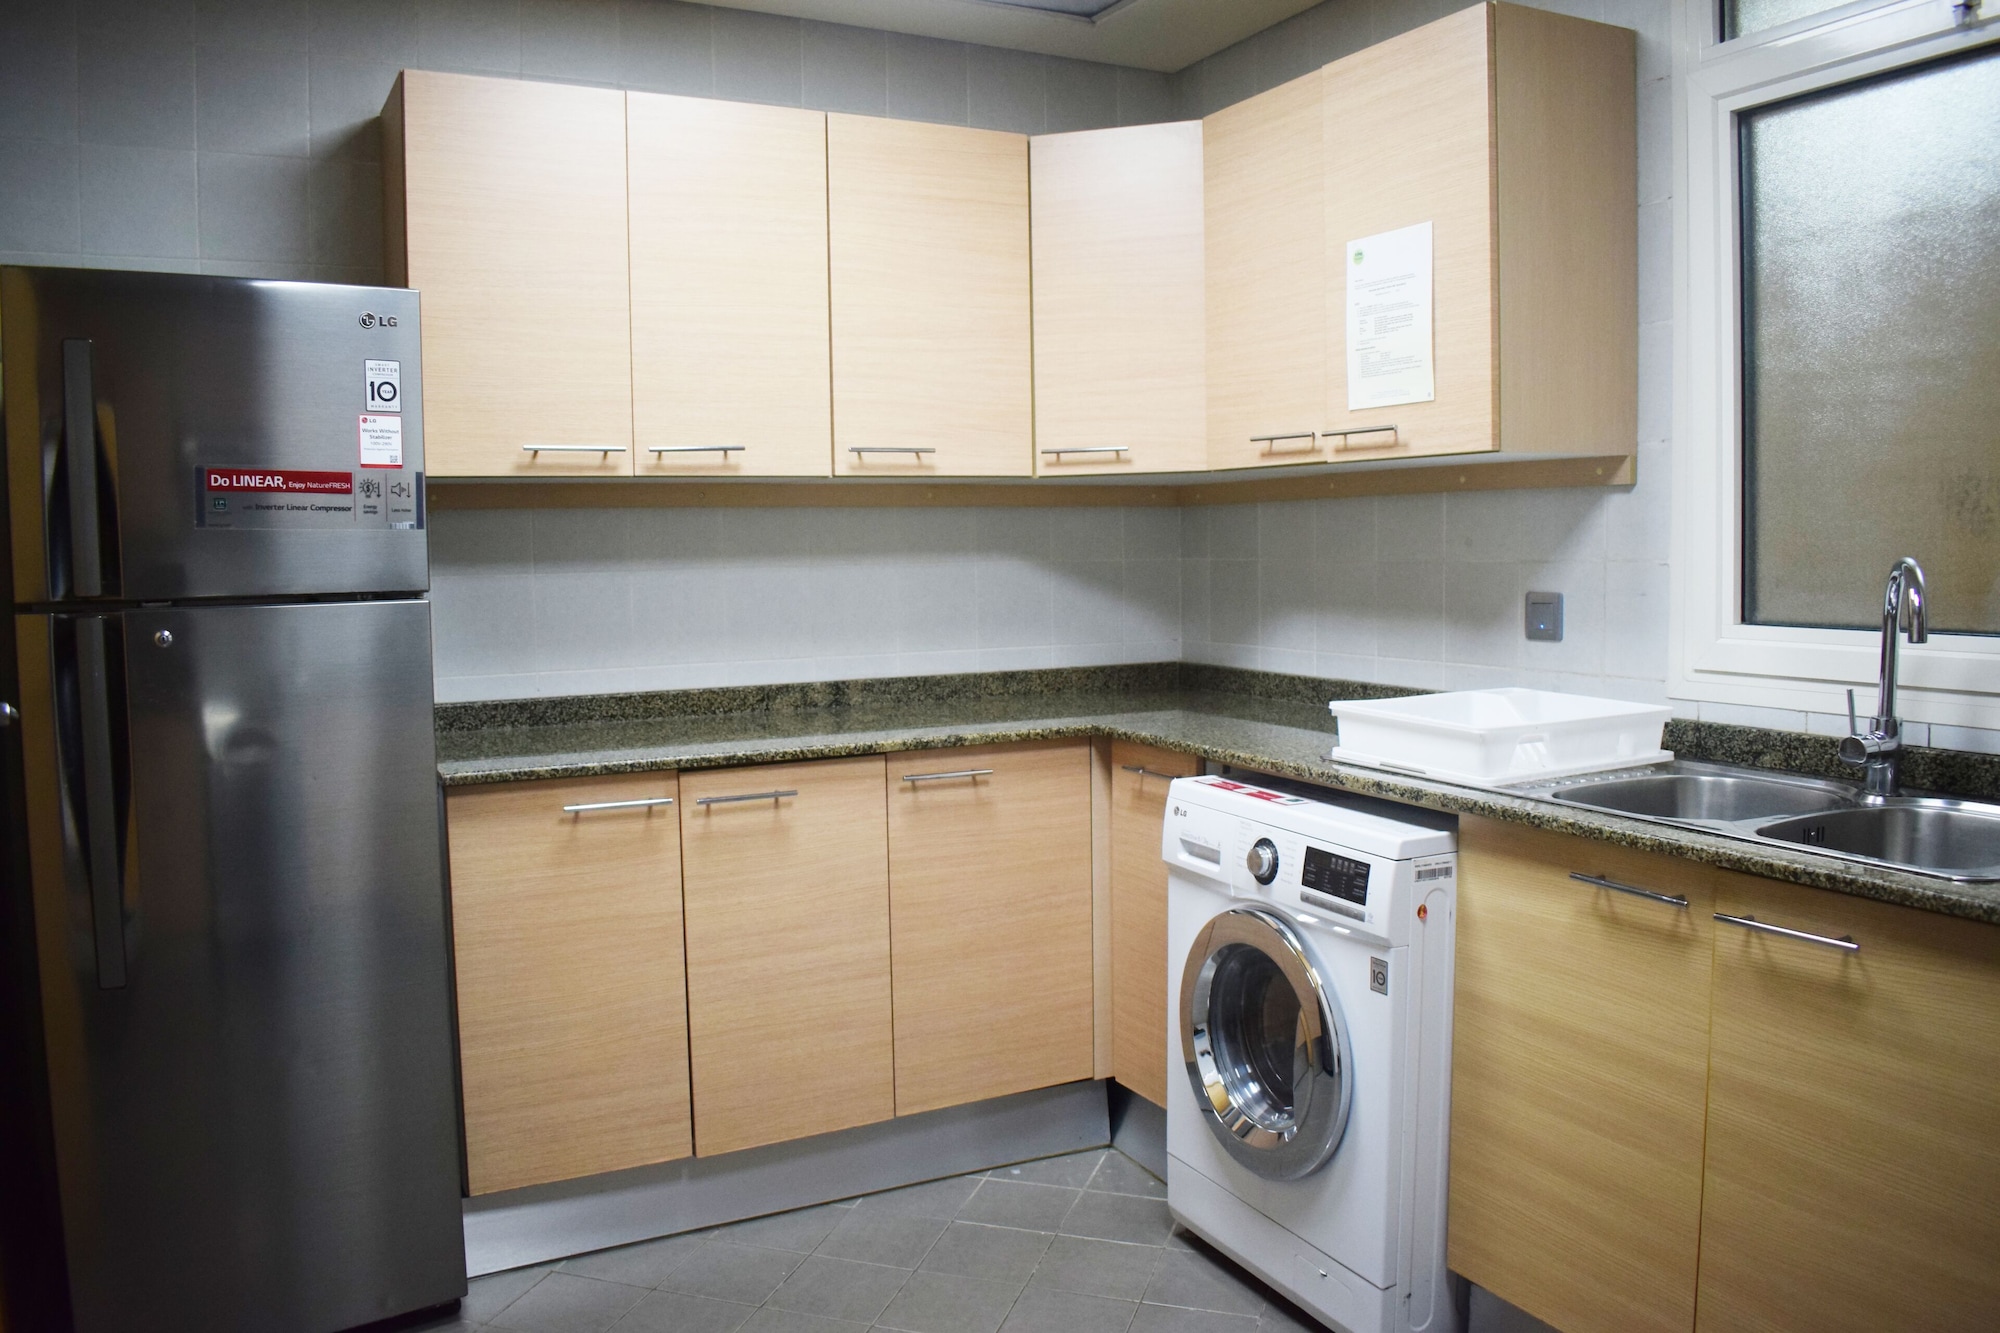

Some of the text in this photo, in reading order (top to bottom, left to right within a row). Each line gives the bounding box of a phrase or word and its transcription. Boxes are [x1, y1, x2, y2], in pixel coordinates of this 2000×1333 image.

[379, 316, 398, 327] LG
[369, 380, 398, 402] 10
[210, 474, 351, 490] Do LINEAR, Enjoy NatureFRESH
[255, 503, 285, 511] Inverter
[286, 503, 308, 511] Linear
[310, 504, 353, 513] Compressor
[1372, 968, 1386, 986] 10
